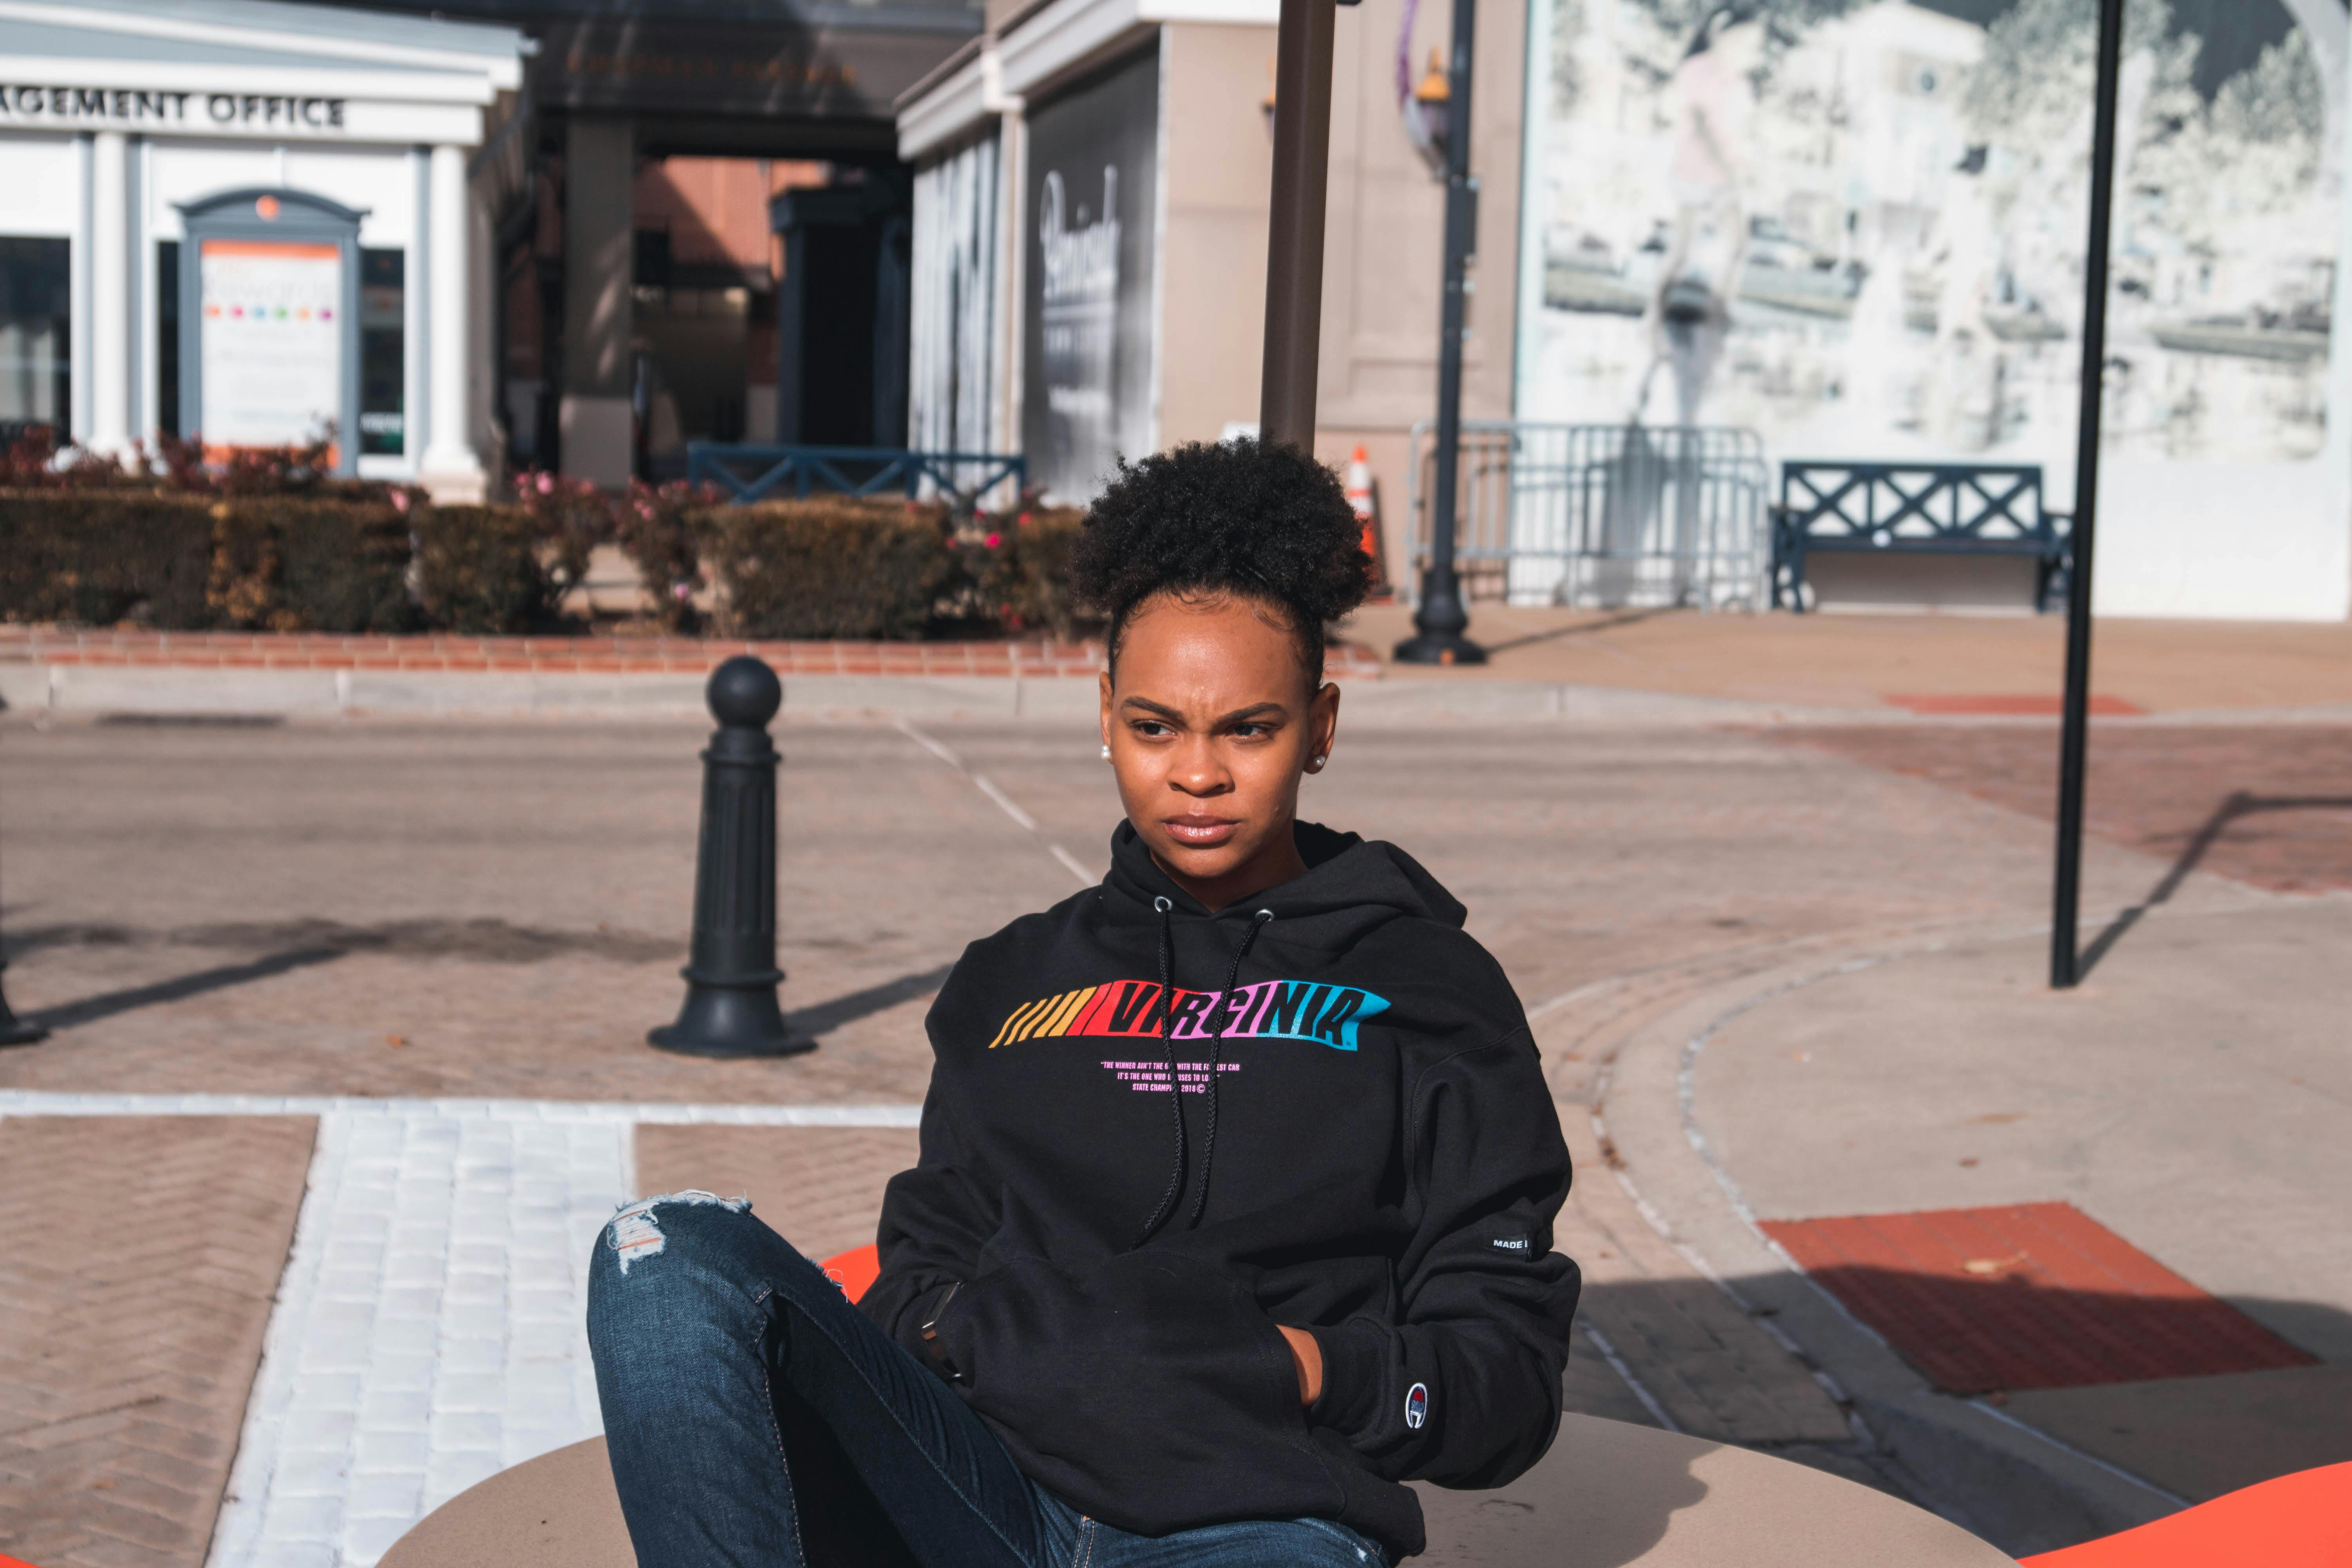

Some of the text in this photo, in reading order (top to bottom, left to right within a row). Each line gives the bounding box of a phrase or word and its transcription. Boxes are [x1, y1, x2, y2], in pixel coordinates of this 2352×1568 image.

[207, 95, 345, 127] OFFICE
[1107, 982, 1366, 1047] VIRGINIA
[1493, 1240, 1523, 1249] MADE
